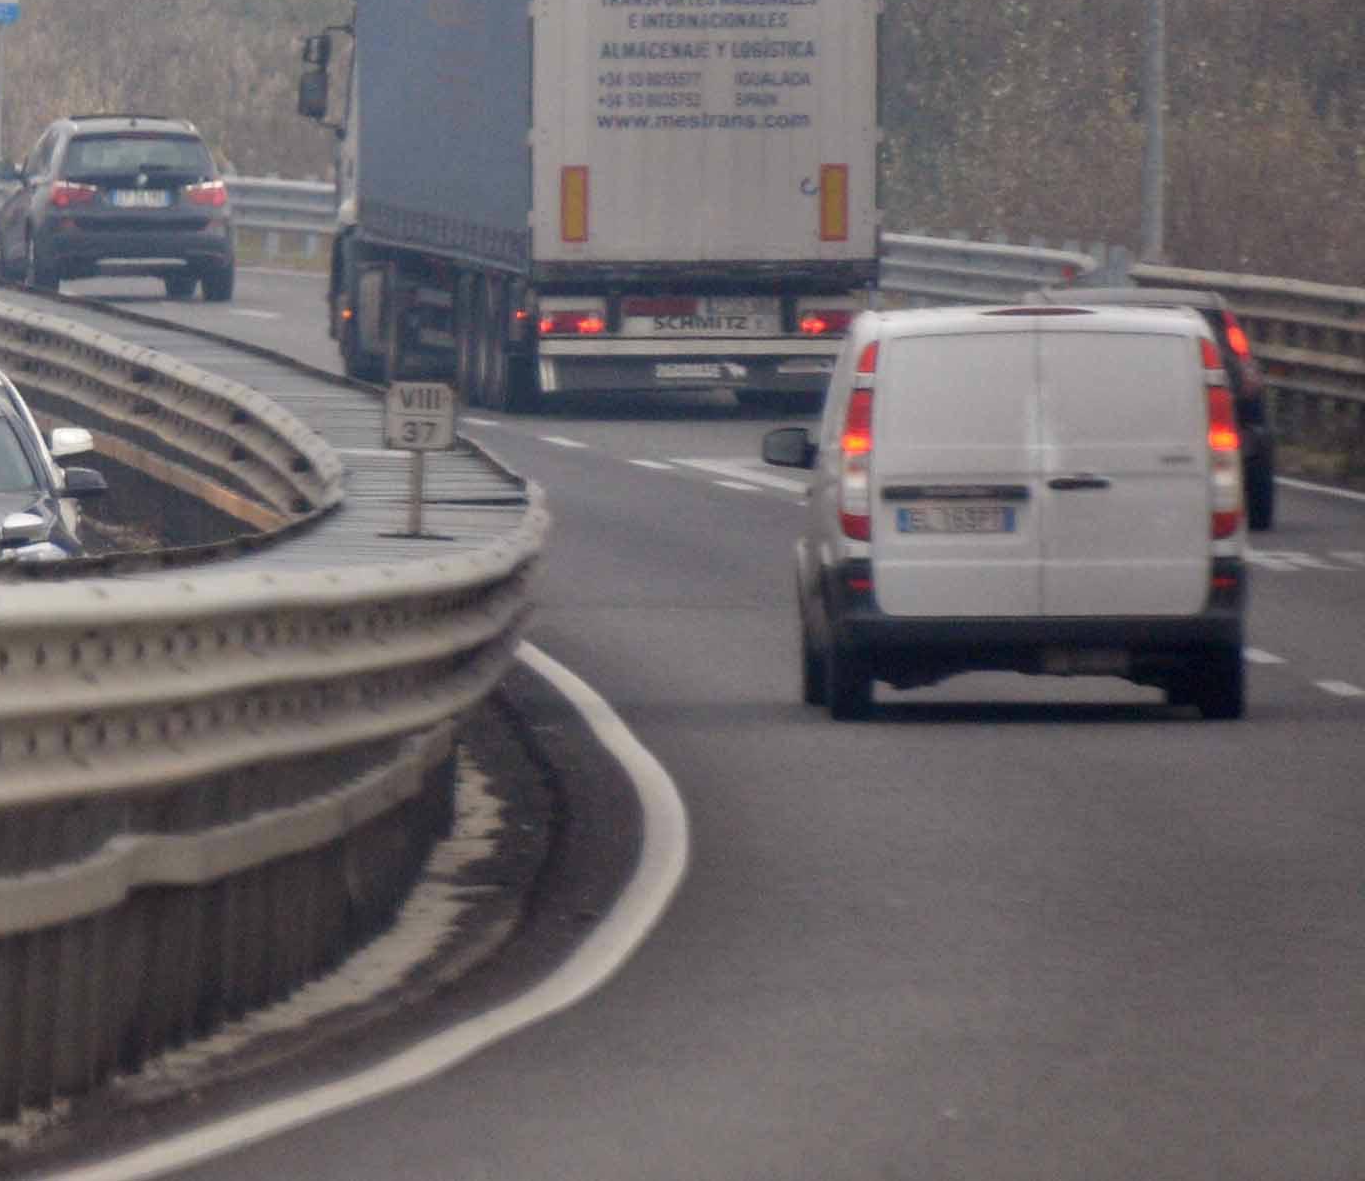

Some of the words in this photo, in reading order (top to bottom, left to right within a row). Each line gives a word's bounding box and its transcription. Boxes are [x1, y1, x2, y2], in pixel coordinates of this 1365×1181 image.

[642, 12, 789, 28] INTERNACIONALES
[600, 42, 709, 59] ALMACENAJE
[716, 42, 726, 58] Y
[597, 112, 812, 130] www.mestrans.com
[653, 315, 749, 331] SCHMITZ
[400, 387, 440, 409] VIII
[402, 421, 438, 443] 37
